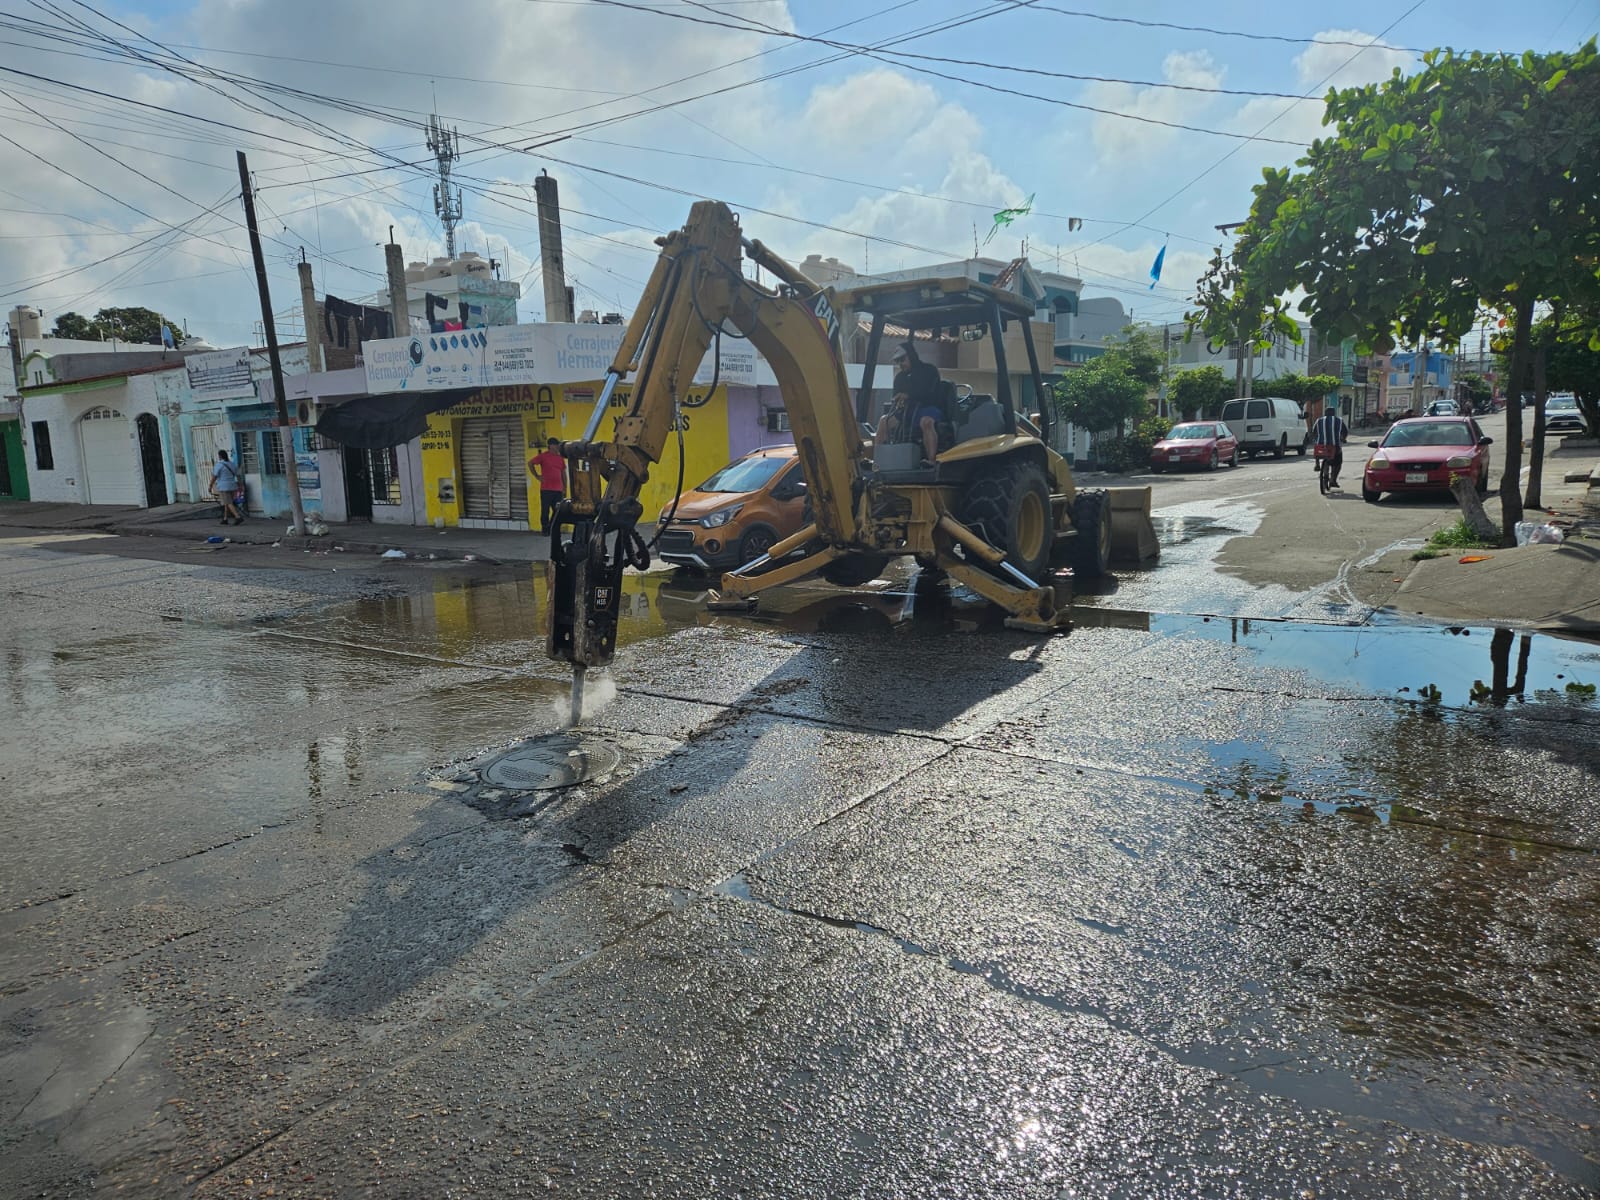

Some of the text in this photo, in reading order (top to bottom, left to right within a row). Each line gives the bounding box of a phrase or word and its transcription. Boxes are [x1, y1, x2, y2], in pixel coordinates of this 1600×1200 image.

[814, 293, 840, 340] CAT
[557, 350, 611, 369] Herman
[597, 589, 608, 598] CAT
